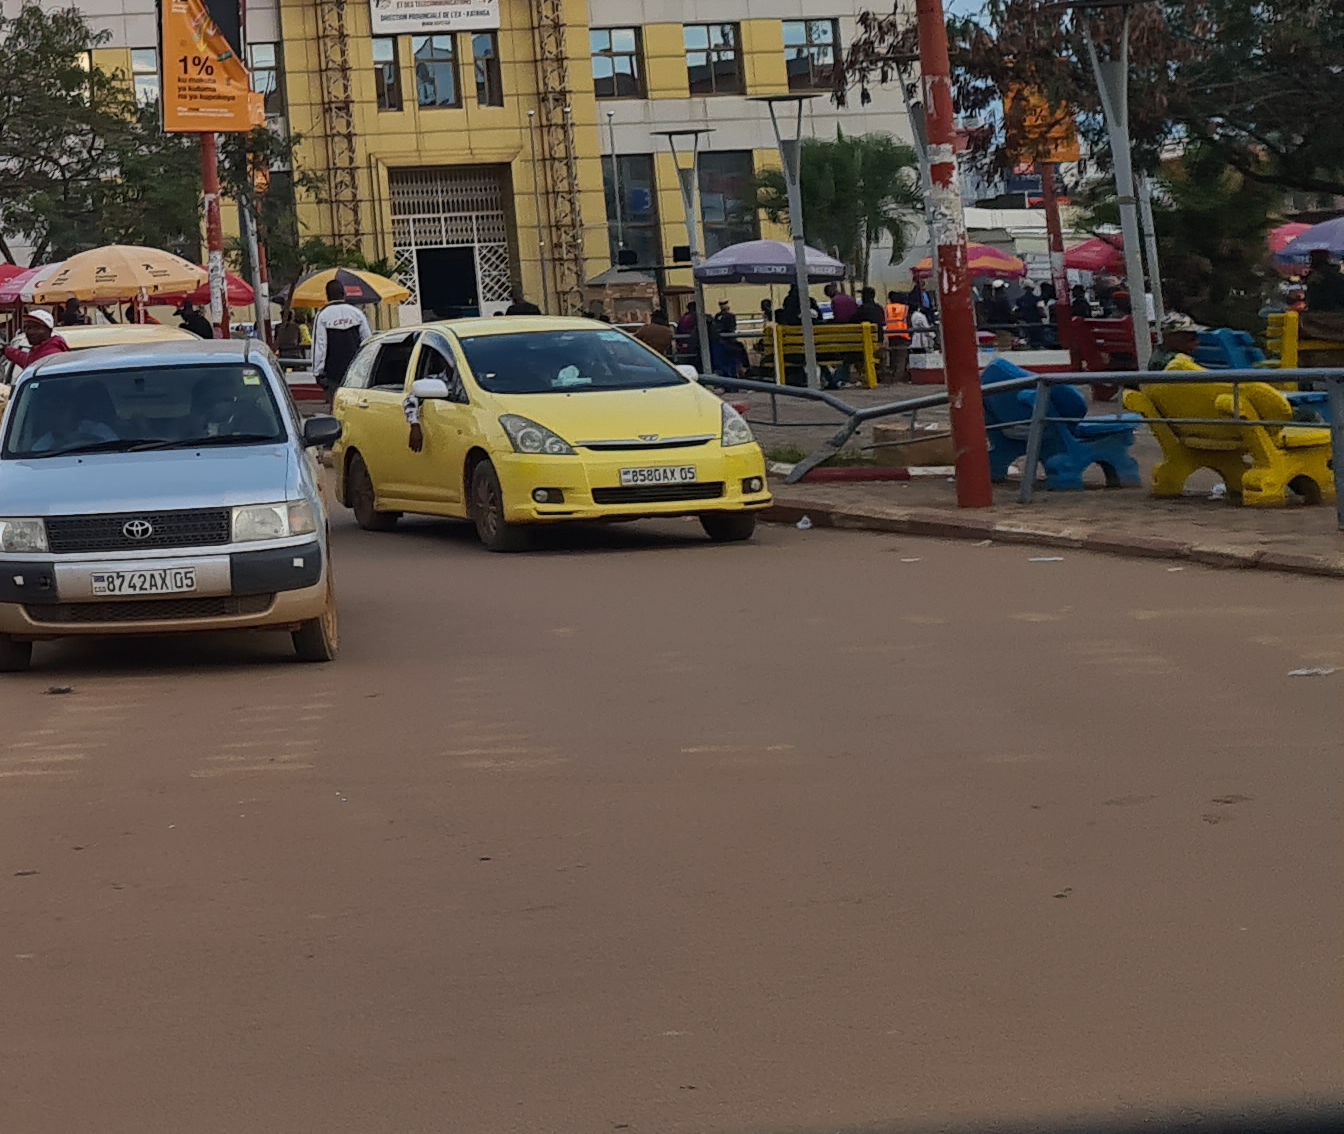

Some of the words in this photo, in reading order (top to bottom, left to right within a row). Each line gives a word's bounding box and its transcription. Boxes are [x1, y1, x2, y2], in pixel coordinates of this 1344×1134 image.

[178, 55, 215, 76] 1%
[631, 468, 676, 483] 8580AX
[679, 467, 696, 480] 05
[106, 572, 169, 592] 8742AX
[173, 570, 194, 589] 05
